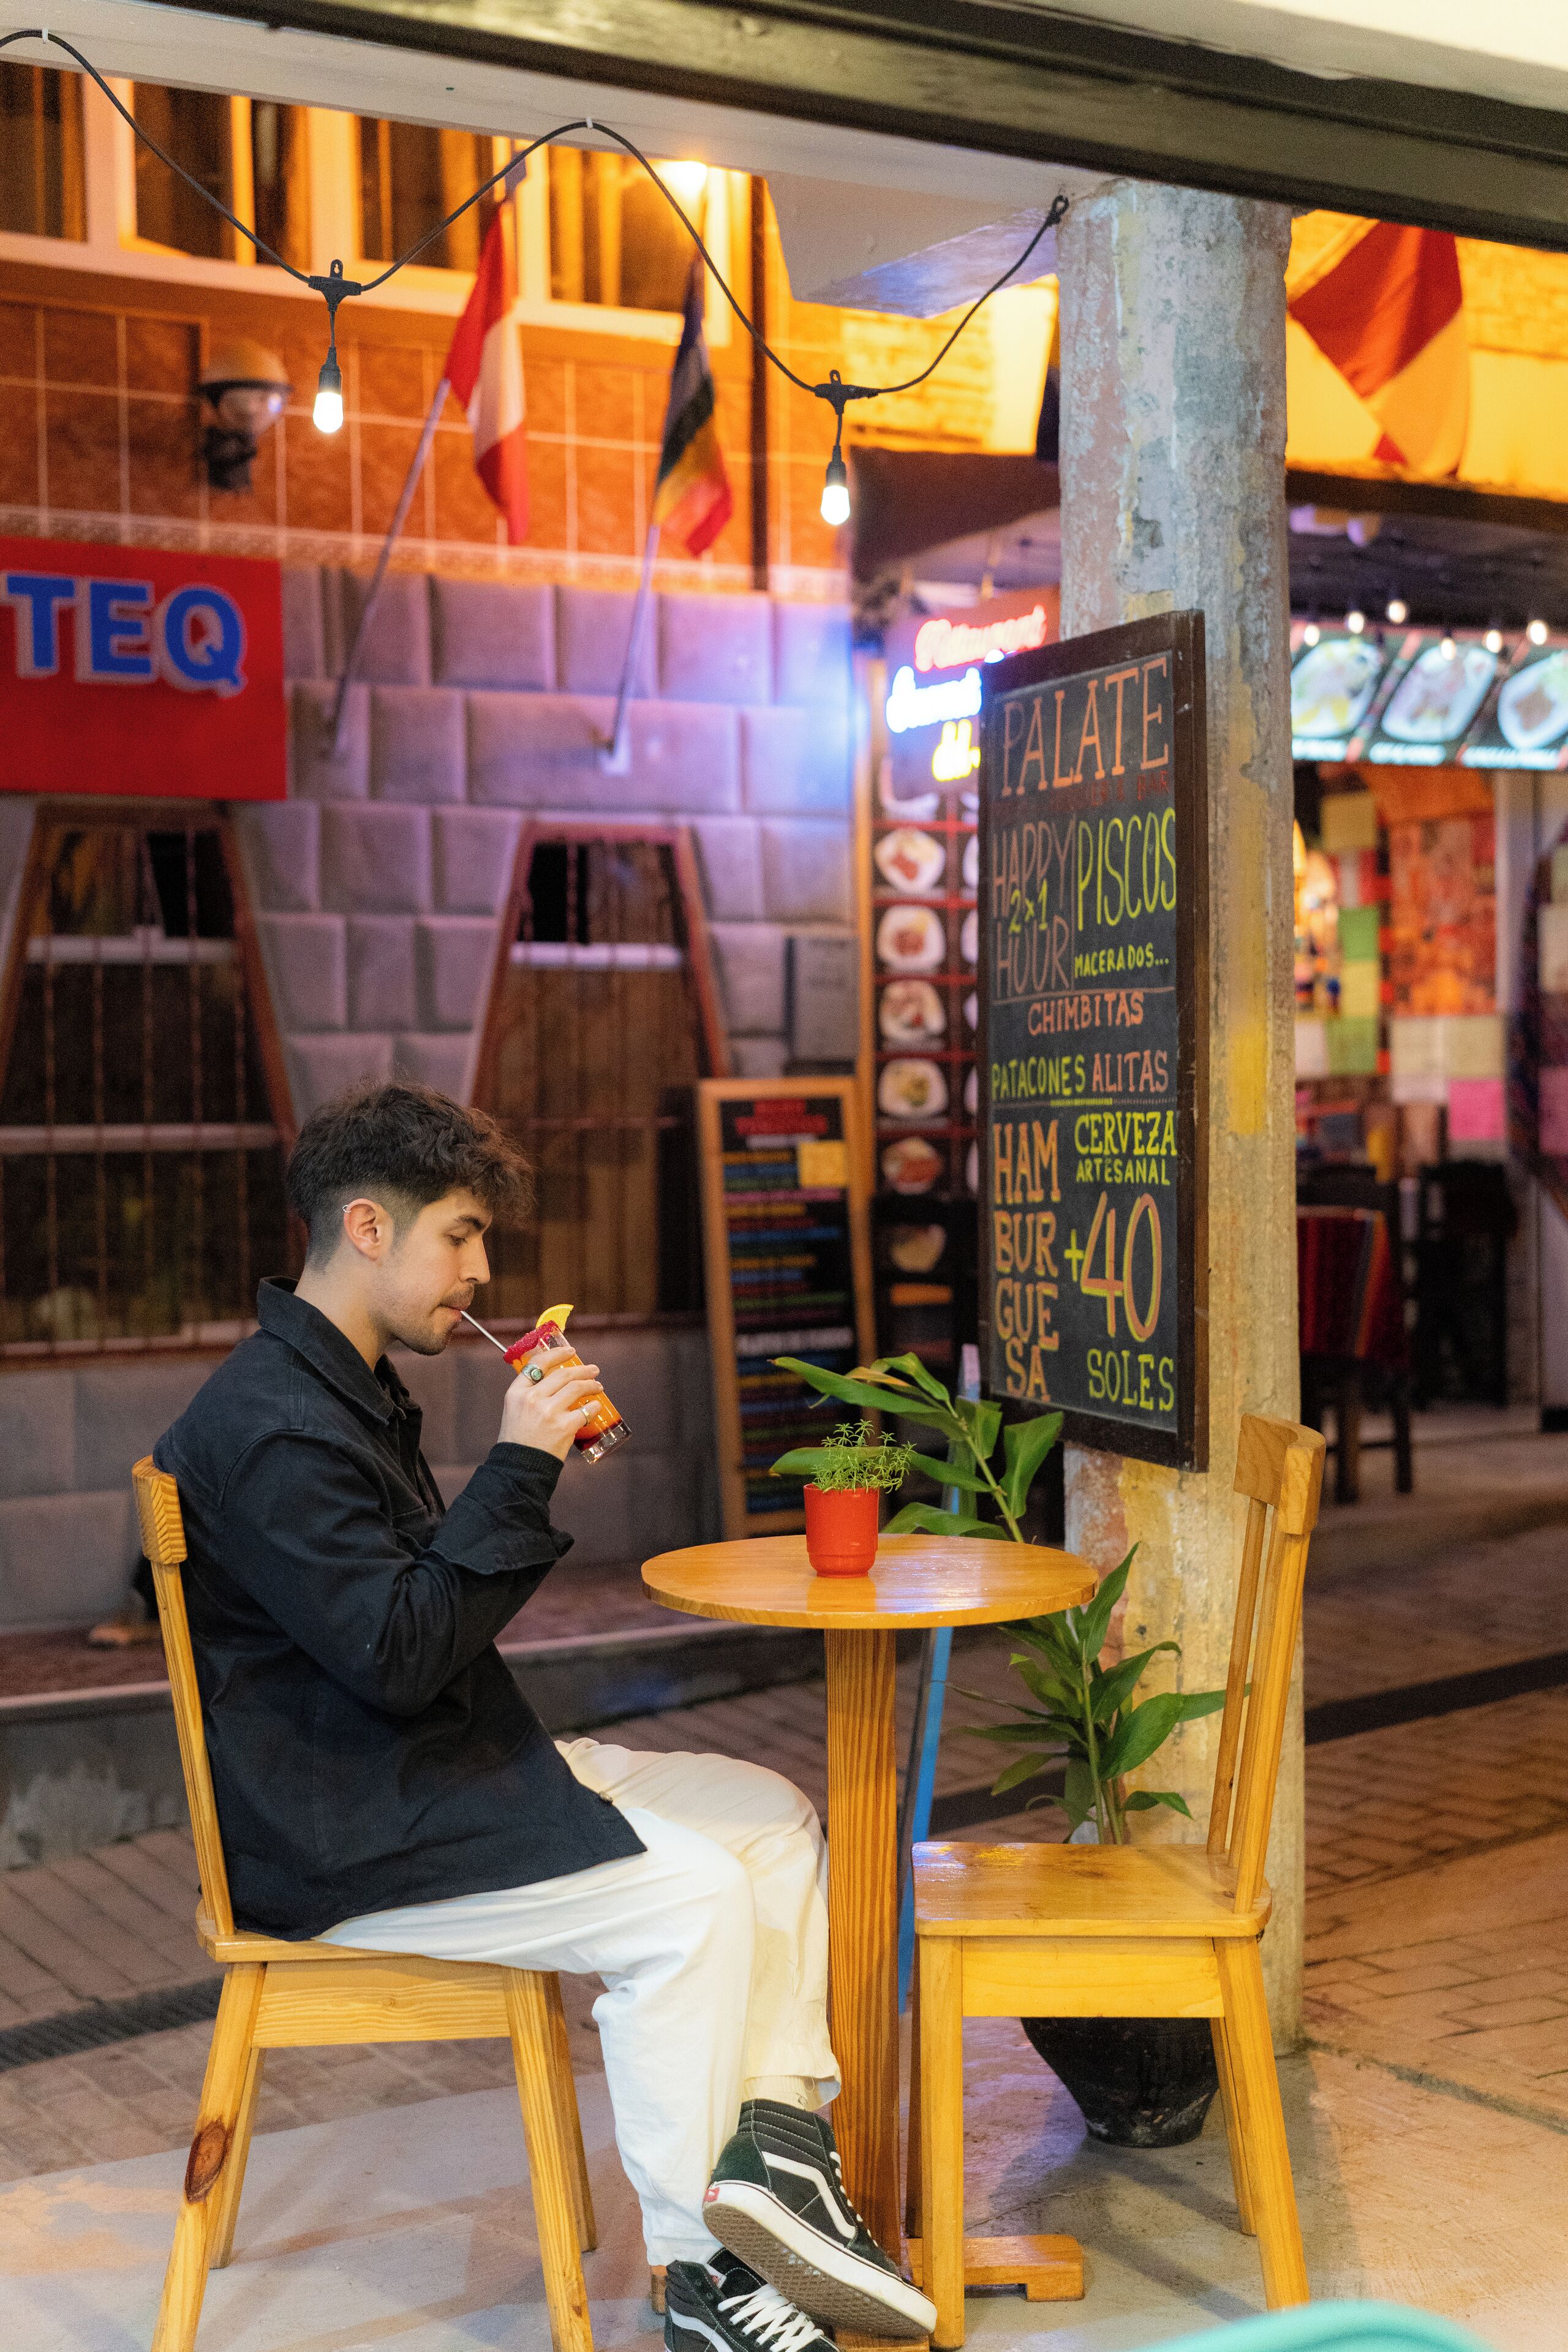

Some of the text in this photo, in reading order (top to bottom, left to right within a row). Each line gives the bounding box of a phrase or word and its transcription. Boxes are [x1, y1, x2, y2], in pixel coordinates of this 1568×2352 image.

[2, 571, 246, 696] TEQ
[1001, 657, 1169, 797] PALATE
[992, 818, 1074, 919] HAPPY
[1077, 806, 1177, 931] PISCOS
[995, 914, 1071, 1000] HOUR
[1027, 990, 1144, 1036] CHIMBITAS
[991, 1054, 1087, 1101] PATACONES
[1092, 1049, 1169, 1093] ALITAS
[992, 1119, 1061, 1205] HAM
[1074, 1110, 1178, 1156] CERVEZA
[1076, 1158, 1171, 1186] ARTESANAL
[993, 1210, 1059, 1278] BUR
[1064, 1191, 1163, 1342] +40
[995, 1276, 1060, 1351] GUE
[1005, 1336, 1052, 1404] SA
[1087, 1348, 1175, 1411] SOLES
